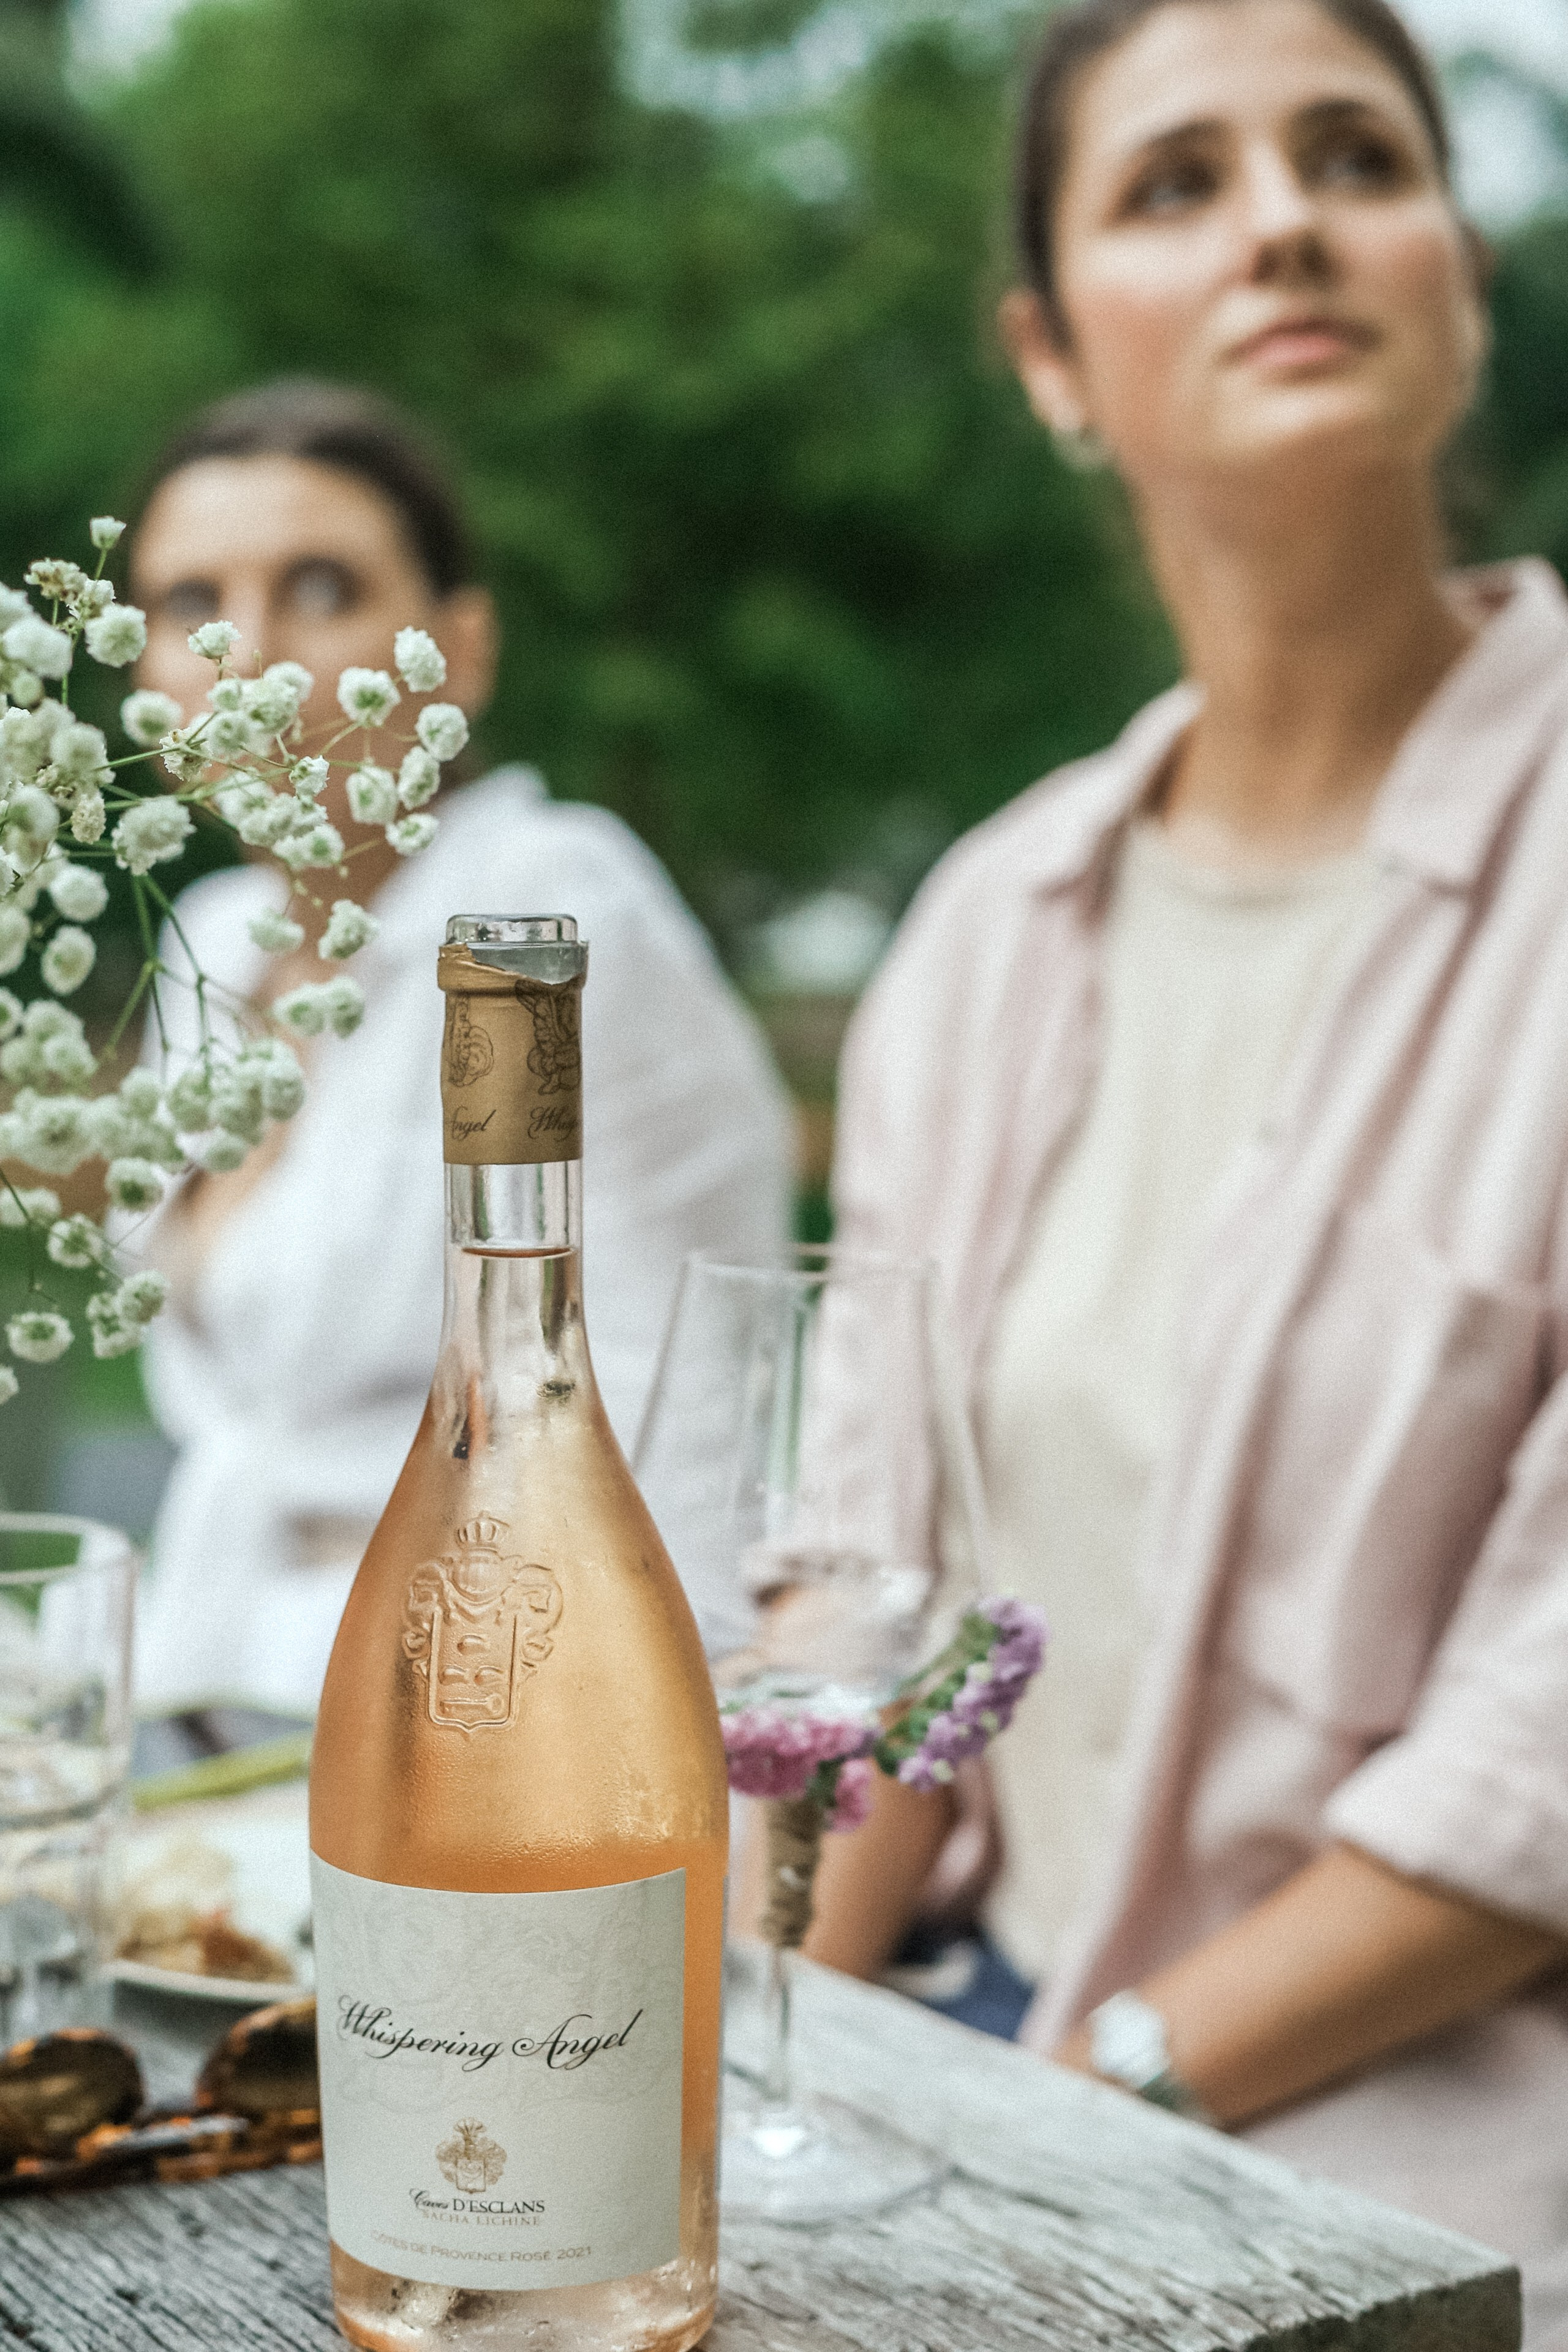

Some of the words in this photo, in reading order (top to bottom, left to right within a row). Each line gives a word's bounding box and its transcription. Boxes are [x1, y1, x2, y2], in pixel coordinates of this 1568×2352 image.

[338, 1994, 503, 2071] Whispering
[512, 2009, 643, 2071] Angel
[409, 2188, 449, 2211] Caves
[453, 2198, 545, 2214] D'ESCLANS
[423, 2210, 469, 2225] SACHA
[476, 2215, 541, 2226] LICHINE
[410, 2242, 427, 2255] DE
[431, 2245, 507, 2262] PROVENCE
[557, 2245, 592, 2260] 2021
